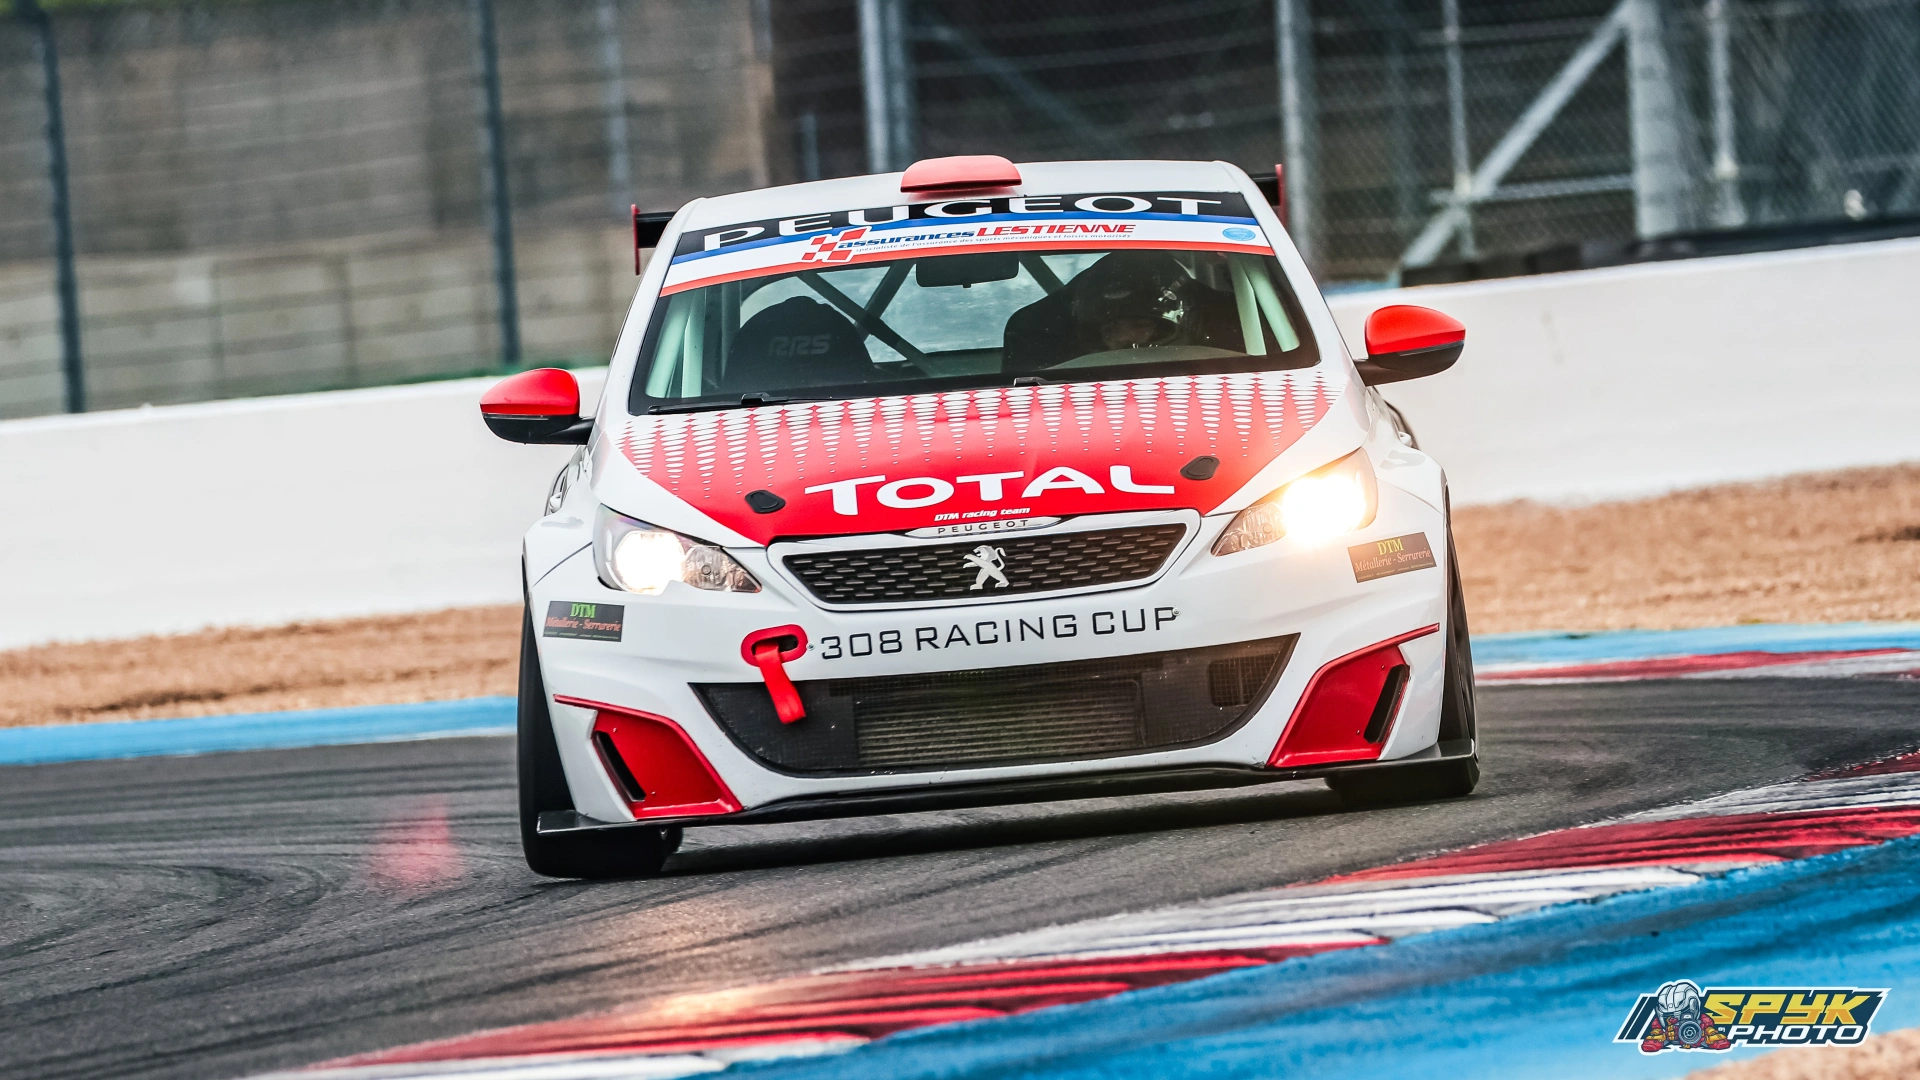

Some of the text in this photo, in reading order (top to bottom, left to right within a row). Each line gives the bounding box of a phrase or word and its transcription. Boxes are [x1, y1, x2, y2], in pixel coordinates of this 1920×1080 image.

[704, 195, 1221, 251] PEUGEOT
[838, 224, 1136, 248] assurances LESTIENNE
[804, 464, 1175, 516] TOTAL
[934, 507, 1031, 521] DTM racing team
[938, 520, 1028, 534] PEUGEOT
[1376, 538, 1405, 556] DTM
[1355, 555, 1393, 572] Métallerie
[1397, 547, 1432, 563] Serrurerie
[570, 603, 596, 619] DTM
[820, 606, 1177, 660] 308 RACING CUP
